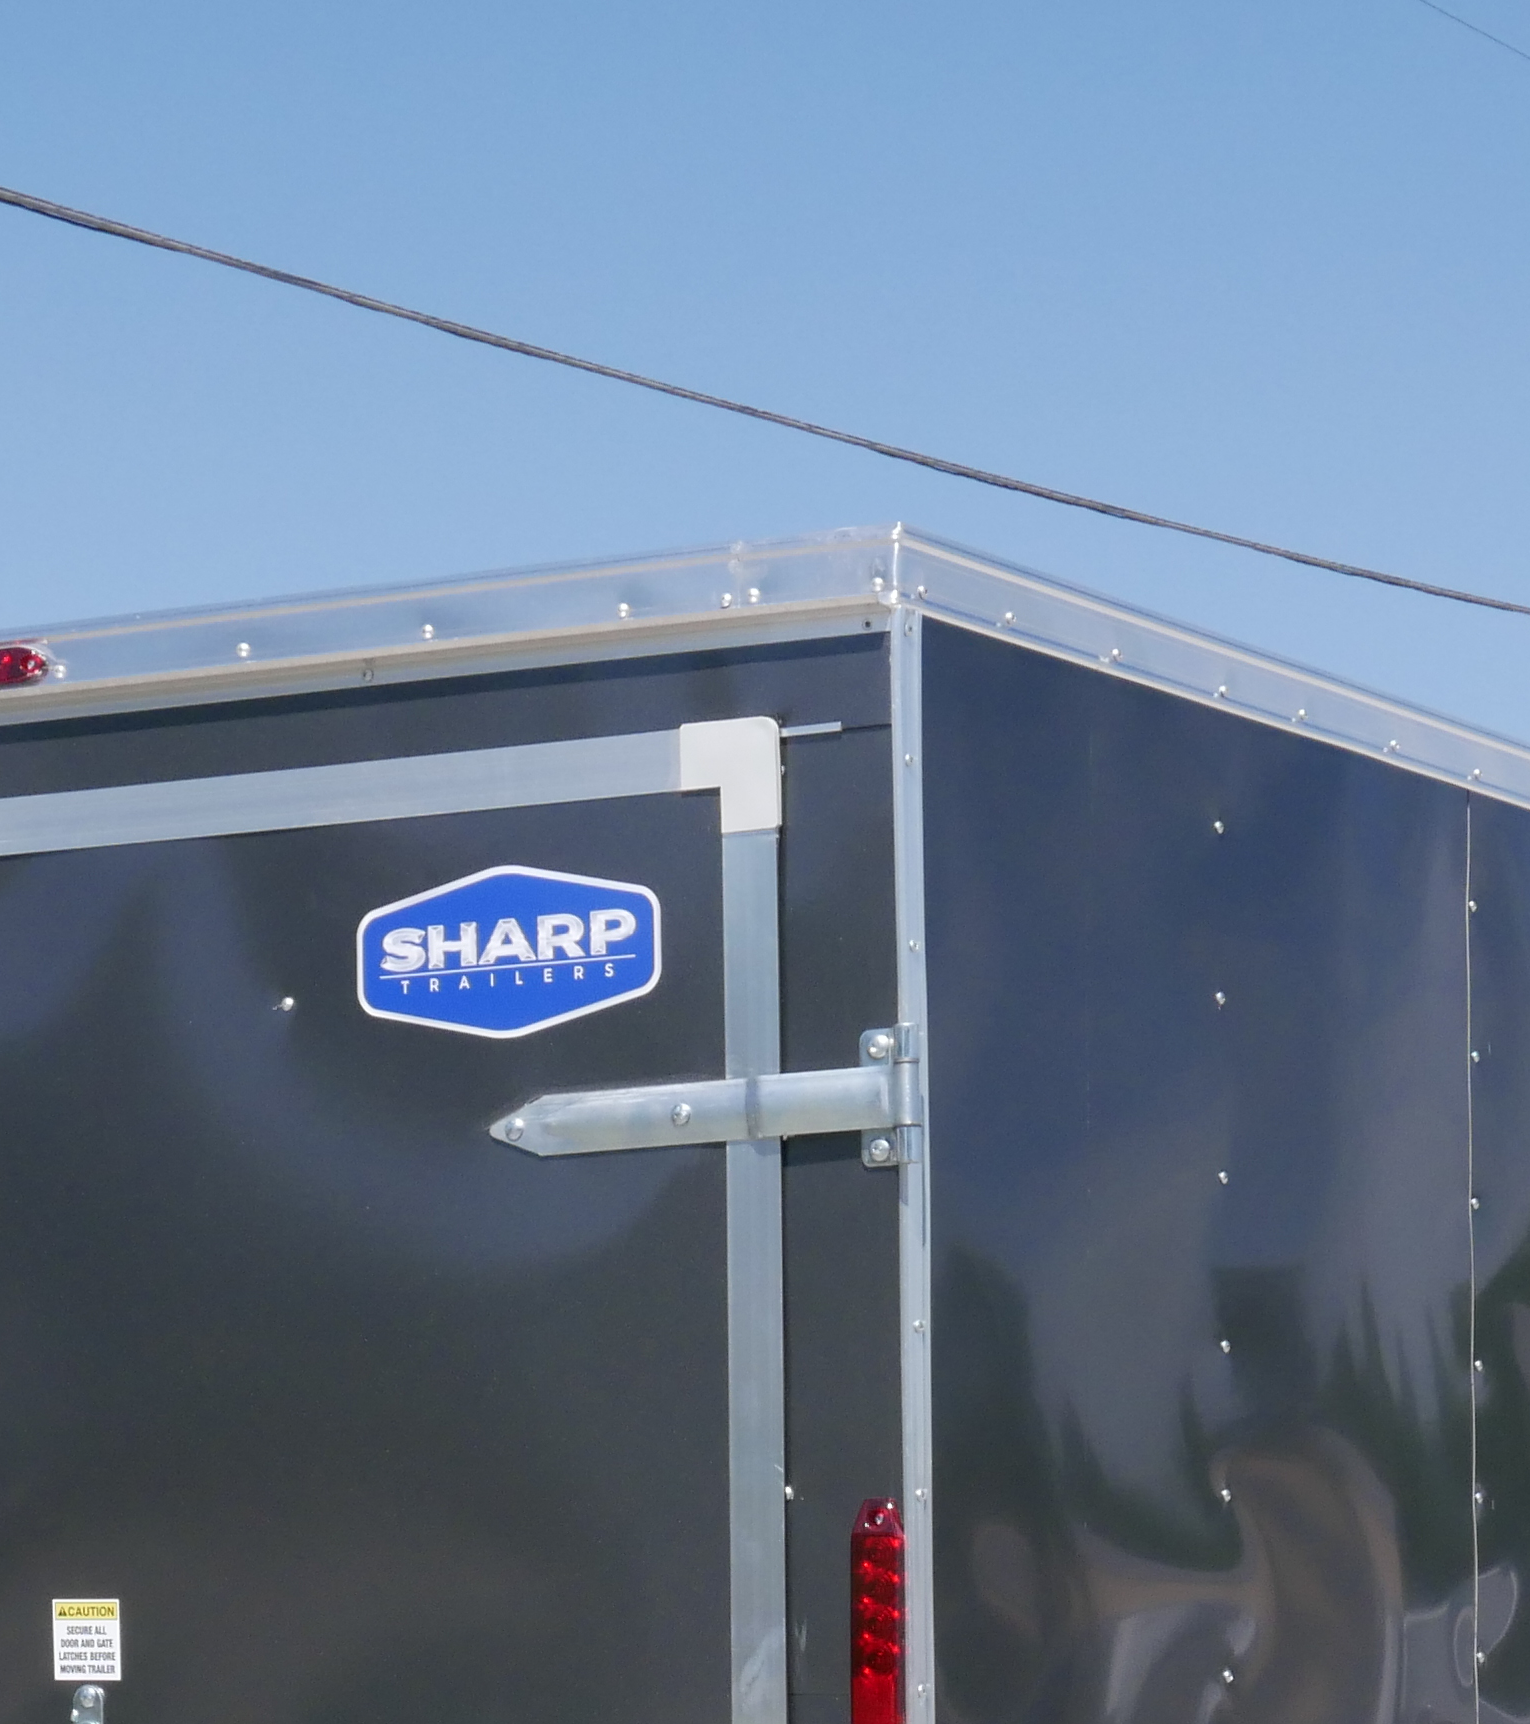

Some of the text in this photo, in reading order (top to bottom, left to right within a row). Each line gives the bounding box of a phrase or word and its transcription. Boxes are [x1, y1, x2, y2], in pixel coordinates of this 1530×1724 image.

[380, 909, 637, 972] SHARP
[400, 963, 615, 995] TRAILERS
[67, 1606, 115, 1617] CAUTION
[66, 1625, 107, 1635] SECURE ALL
[60, 1639, 113, 1648] DOOR AND GATE
[58, 1652, 116, 1661] LATCHES BEFORE
[59, 1665, 116, 1674] MOVING TRAILER
